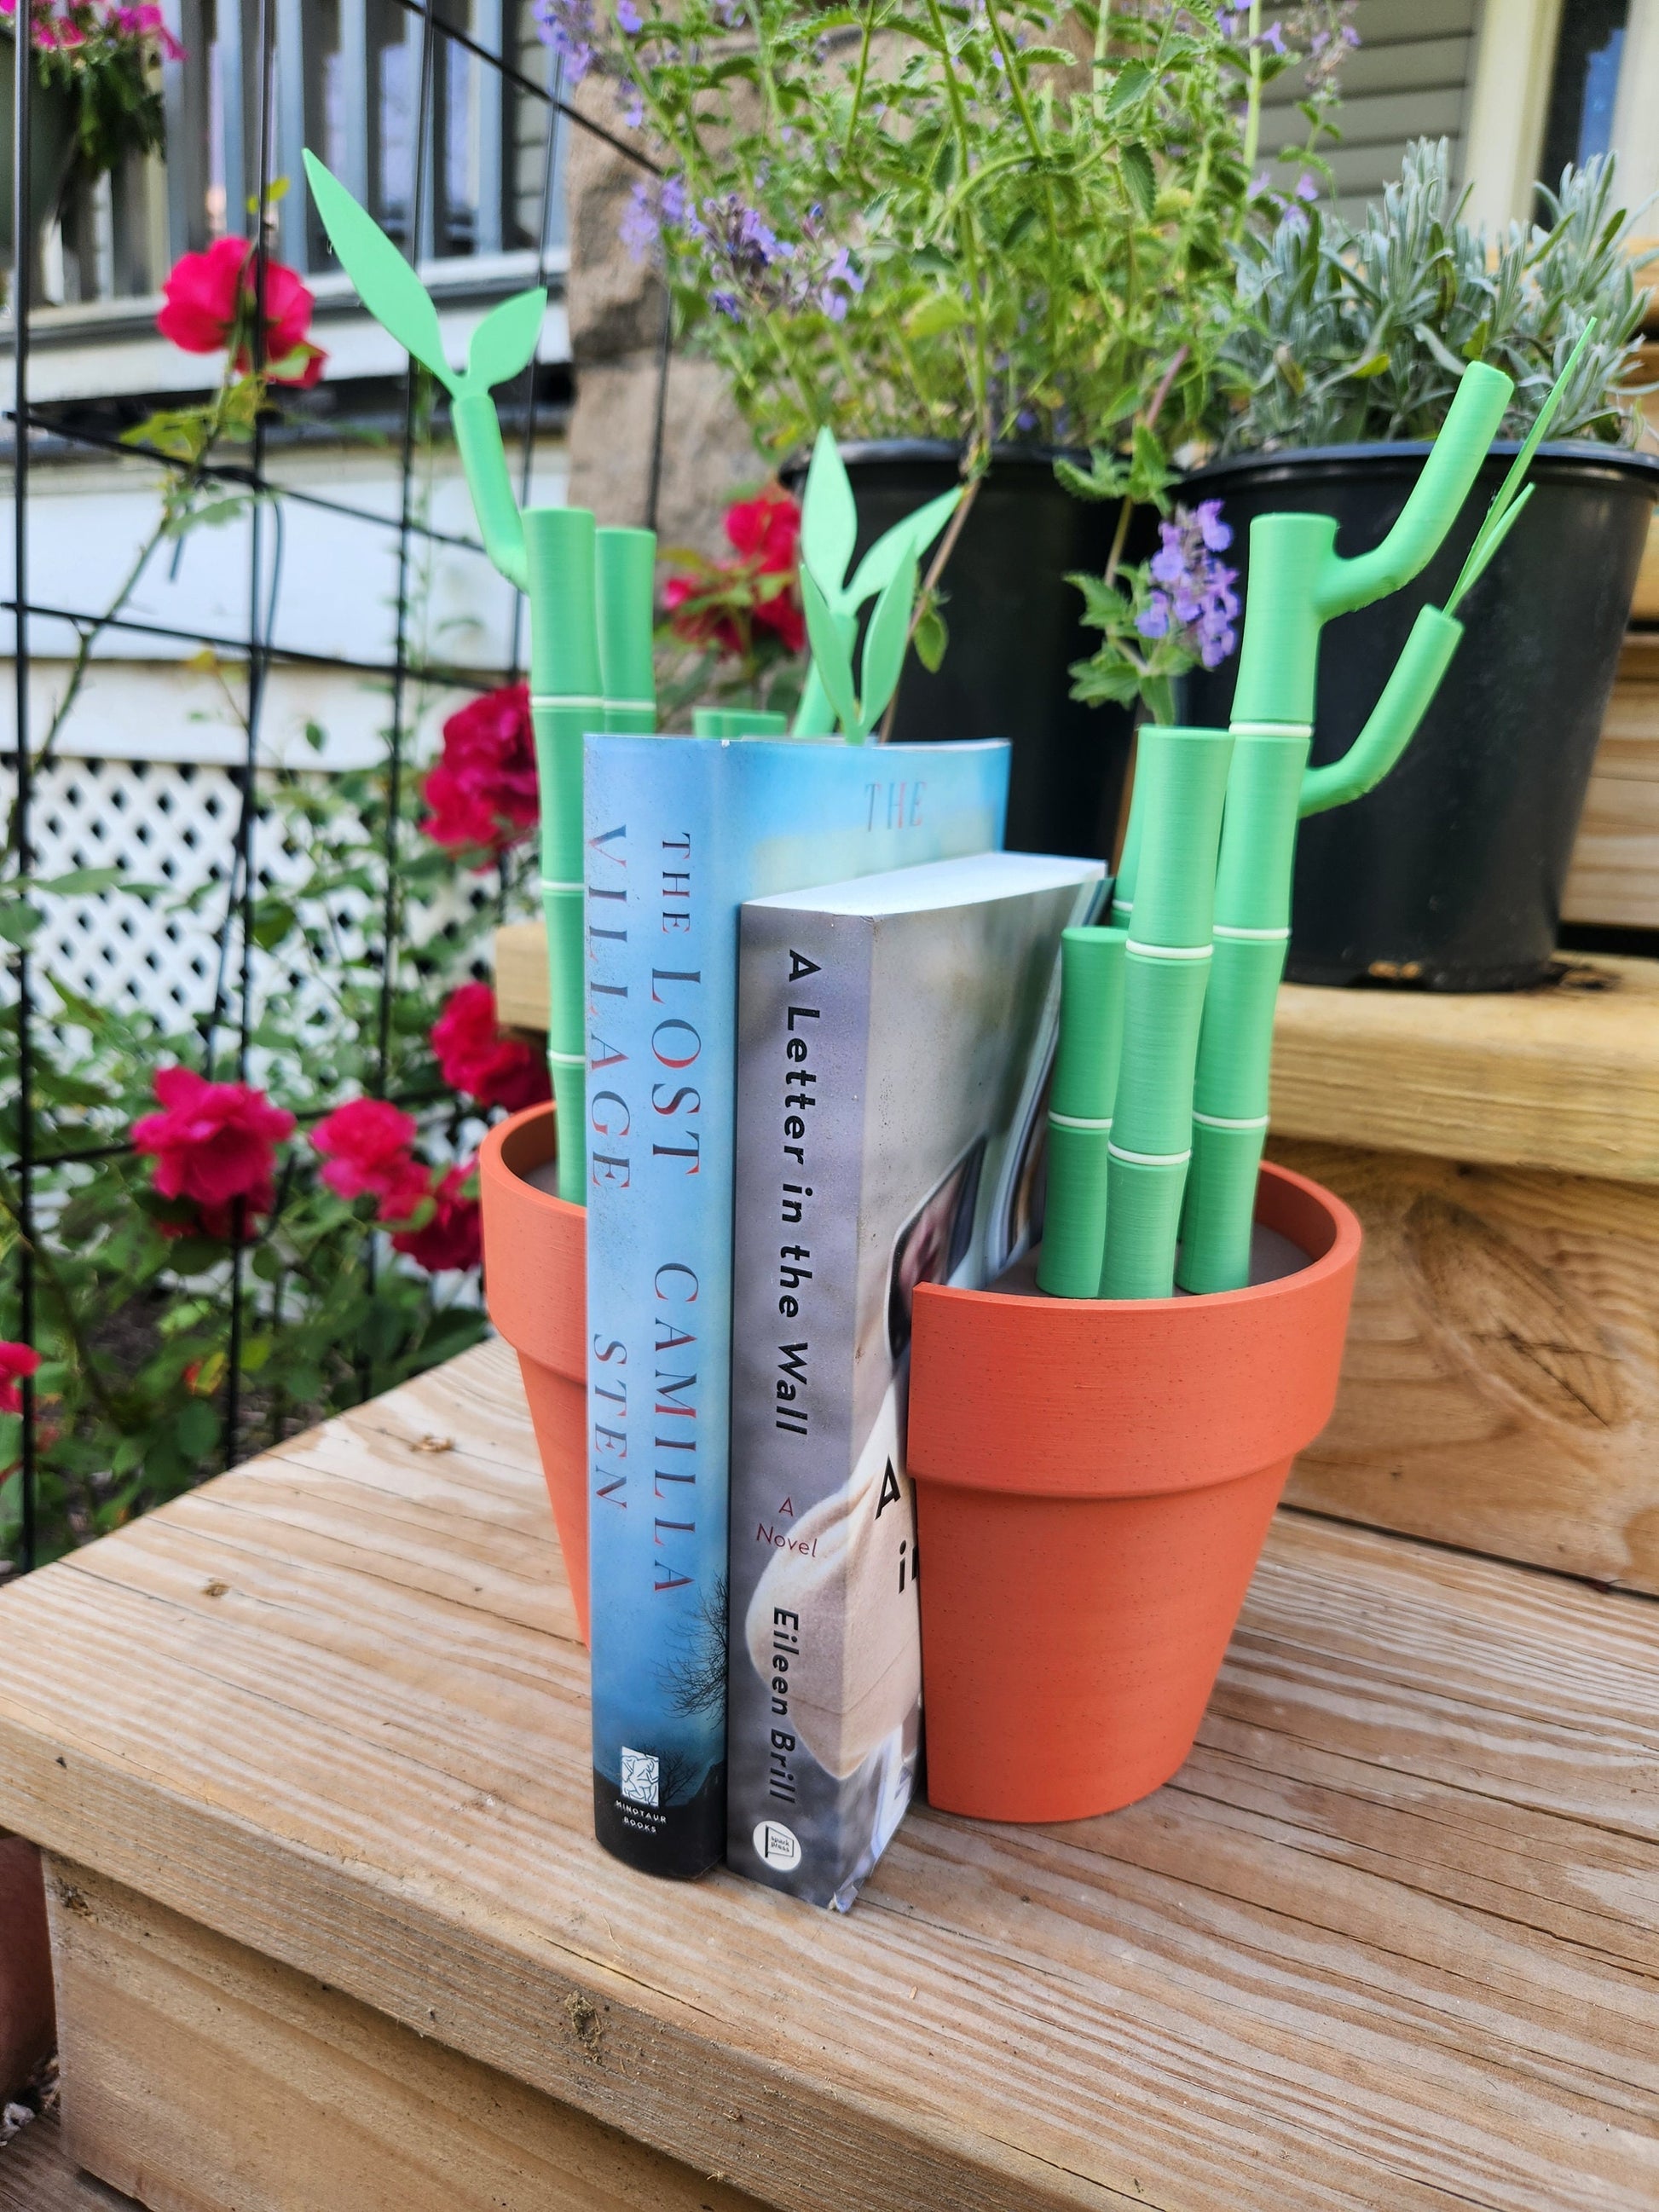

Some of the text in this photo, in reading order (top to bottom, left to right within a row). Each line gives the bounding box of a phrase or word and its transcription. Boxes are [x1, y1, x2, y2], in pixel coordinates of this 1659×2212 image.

[864, 781, 928, 832] THE
[588, 824, 630, 1188] VILLAGE
[652, 832, 702, 1175] THE LOST
[775, 949, 821, 1436] A Letter in the Wall
[592, 1333, 628, 1510] STEN
[653, 1262, 700, 1593] CAMILLA
[778, 1496, 795, 1517] A
[875, 1454, 901, 1521] A
[756, 1522, 818, 1558] Novel
[770, 1606, 800, 1804] Eileen Brill
[615, 1799, 668, 1824] MINOTAUR
[622, 1816, 657, 1834] BOOKS
[771, 1842, 790, 1853] press
